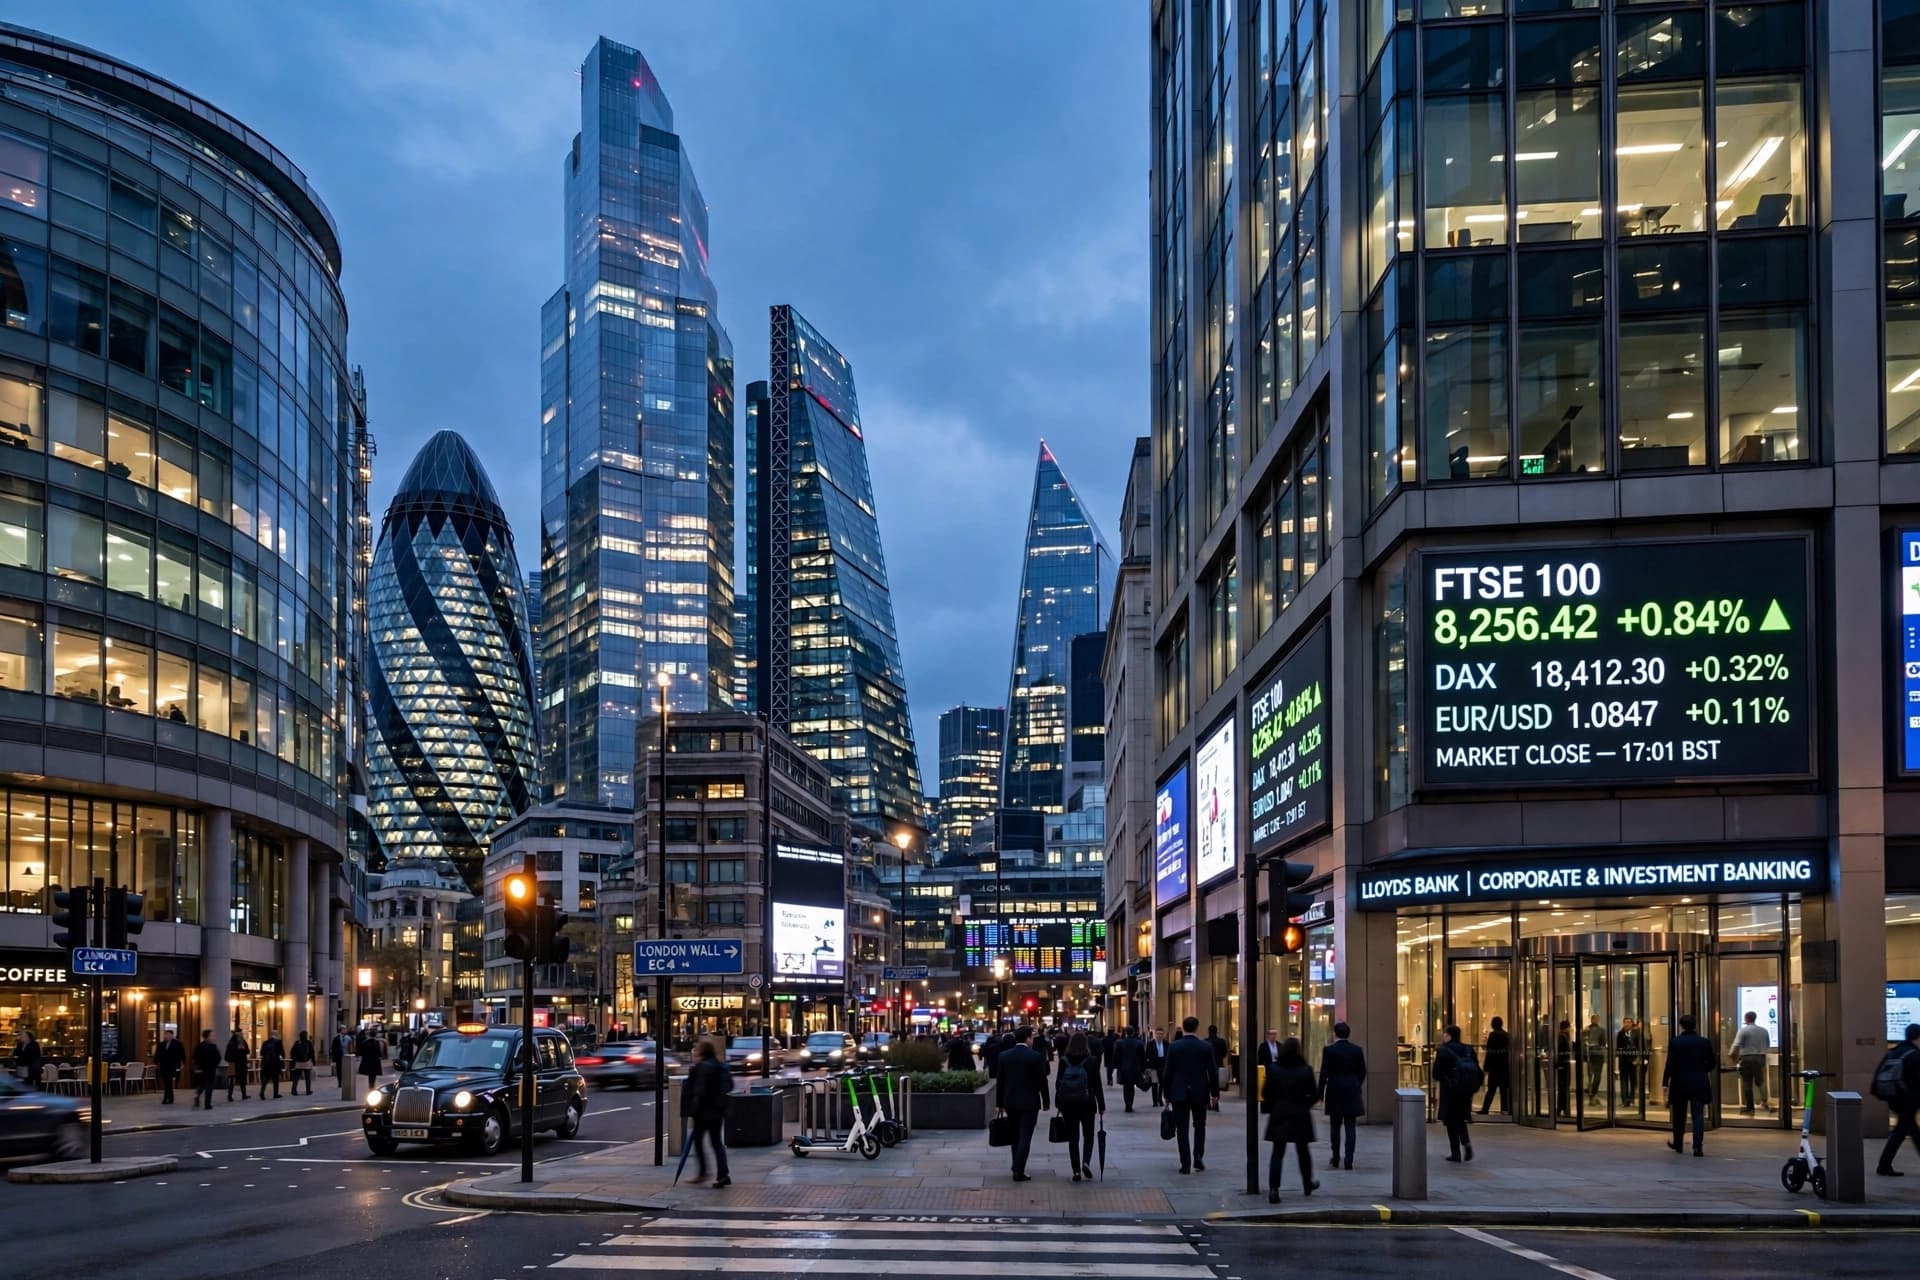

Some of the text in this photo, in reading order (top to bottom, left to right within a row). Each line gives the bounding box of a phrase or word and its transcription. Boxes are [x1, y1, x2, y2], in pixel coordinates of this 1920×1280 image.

[1435, 562, 1600, 601] FTSE 100
[1434, 598, 1751, 650] 8,256.42 +0.84%
[1435, 653, 1789, 691] DAX 18,412.30 +0.32%
[1252, 680, 1283, 730] FTSE 100
[1436, 696, 1790, 733] EUR/USD 1.0847 +0.11%
[1436, 745, 1520, 768] MARKET
[1525, 743, 1591, 765] CLOSE
[1622, 741, 1674, 762] 17:01
[1682, 739, 1721, 761] BST
[1252, 765, 1265, 791] DAX
[1298, 758, 1321, 790] +0.11%
[1362, 860, 1811, 900] LLOYDS BANK CORPORATE & INVESTMENT BANKING
[640, 943, 721, 957] LONDON WALL
[648, 959, 675, 971] EC4
